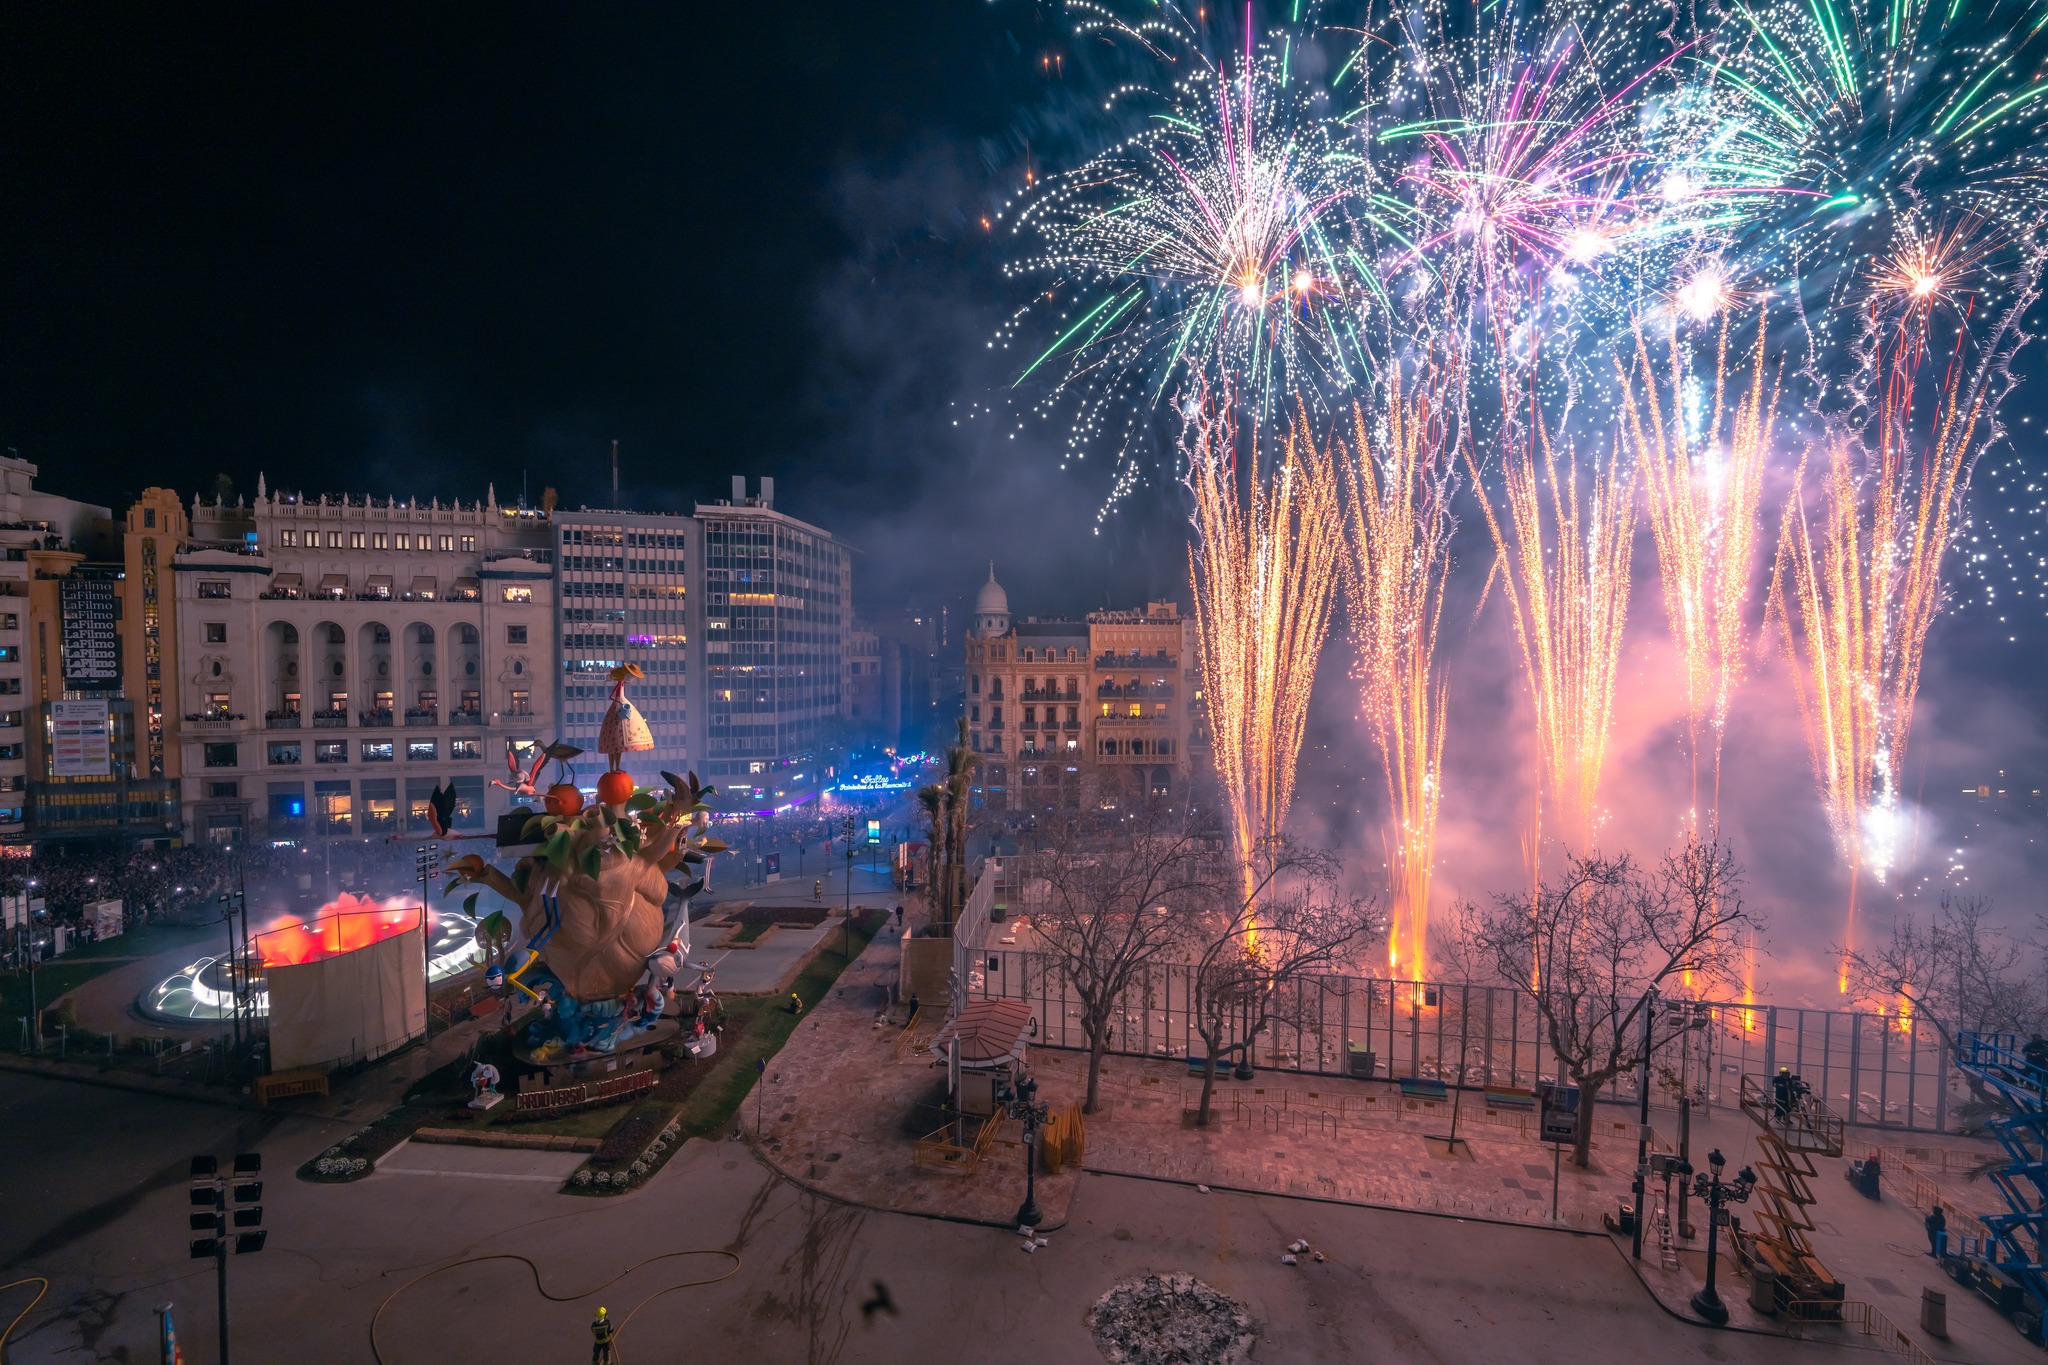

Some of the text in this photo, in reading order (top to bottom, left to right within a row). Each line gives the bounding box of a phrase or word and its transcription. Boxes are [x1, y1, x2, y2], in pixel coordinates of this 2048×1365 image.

[62, 581, 111, 590] LaFilmo
[62, 591, 112, 600] LaFilmo
[63, 600, 112, 610] LaFilmo
[63, 610, 113, 619] LaFilmo
[64, 620, 114, 629] LaFilmo
[64, 630, 114, 639] LaFilmo
[65, 639, 115, 649] LaFilmo
[65, 649, 115, 658] LaFilmo
[65, 658, 116, 668] LaFilmo
[66, 668, 117, 678] LaFilmo
